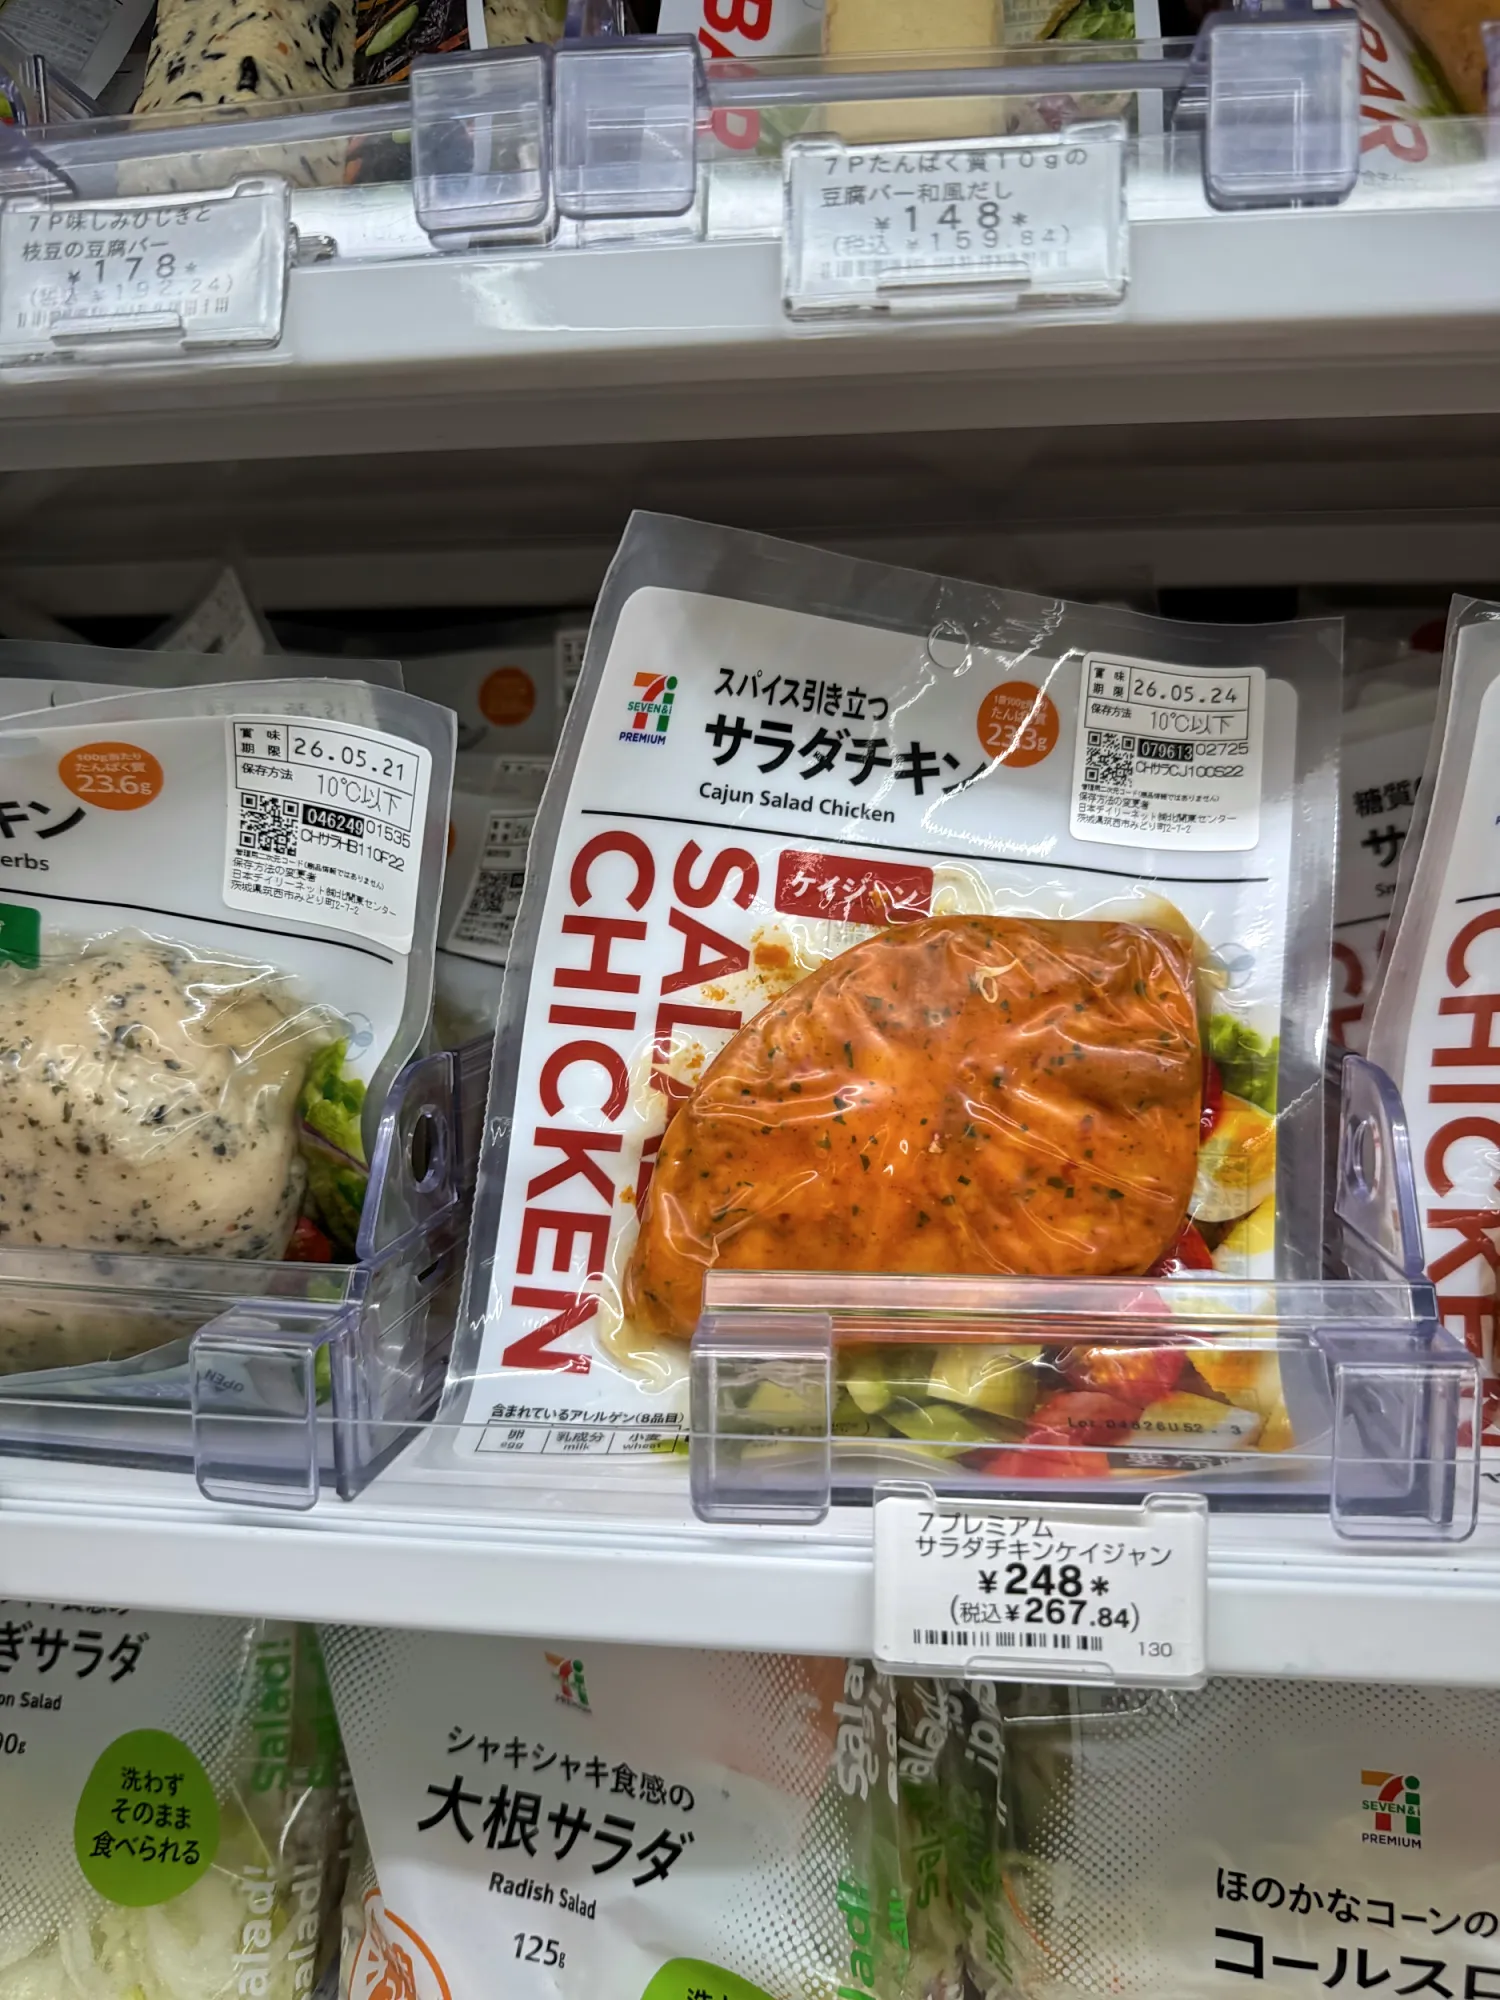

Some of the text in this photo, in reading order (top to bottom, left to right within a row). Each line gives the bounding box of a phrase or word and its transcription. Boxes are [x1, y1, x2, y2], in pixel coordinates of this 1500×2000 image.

[820, 180, 1013, 208] 豆腐バー和風だし
[23, 239, 169, 262] 枝豆の豆腐バー
[713, 668, 888, 721] スパイス引き立つ
[1133, 679, 1237, 703] 26.05.24
[1090, 702, 1235, 736] 保存方法 10℃以下
[619, 732, 666, 745] PREMIUM
[986, 722, 1049, 752] 233g
[1141, 741, 1249, 761] 079613 02725
[294, 737, 404, 781] 26.05.21
[704, 714, 987, 795] サラダチキン
[76, 774, 152, 796] 23.6g
[242, 762, 402, 816] 保存方法 10℃以下
[700, 781, 896, 824] Cajun Salad Chicken
[307, 808, 411, 848] 046249 01535
[501, 830, 656, 1374] CHICKEN
[491, 1403, 684, 1424] 含まれているアレルゲン(8品目)
[917, 1513, 1052, 1538] 7プレミアム
[915, 1536, 1172, 1566] サラダチキンケイジャン
[950, 1597, 1140, 1633] (税込¥267.84)
[0, 1620, 150, 1684] ぎサラダ
[1138, 1643, 1172, 1658] 130
[20, 1692, 62, 1711] Salad
[121, 1766, 184, 1796] 洗わず
[447, 1726, 696, 1812] シャキシャキ食感の
[111, 1799, 191, 1830] そのまま
[417, 1774, 696, 1888] 大根サラダ
[90, 1831, 201, 1865] 食べられる
[1361, 1833, 1422, 1848] PREMIUM
[488, 1872, 597, 1919] Radish Salad
[1216, 1867, 1499, 1938] ほのかなコーンの
[512, 1932, 566, 1969] 125g
